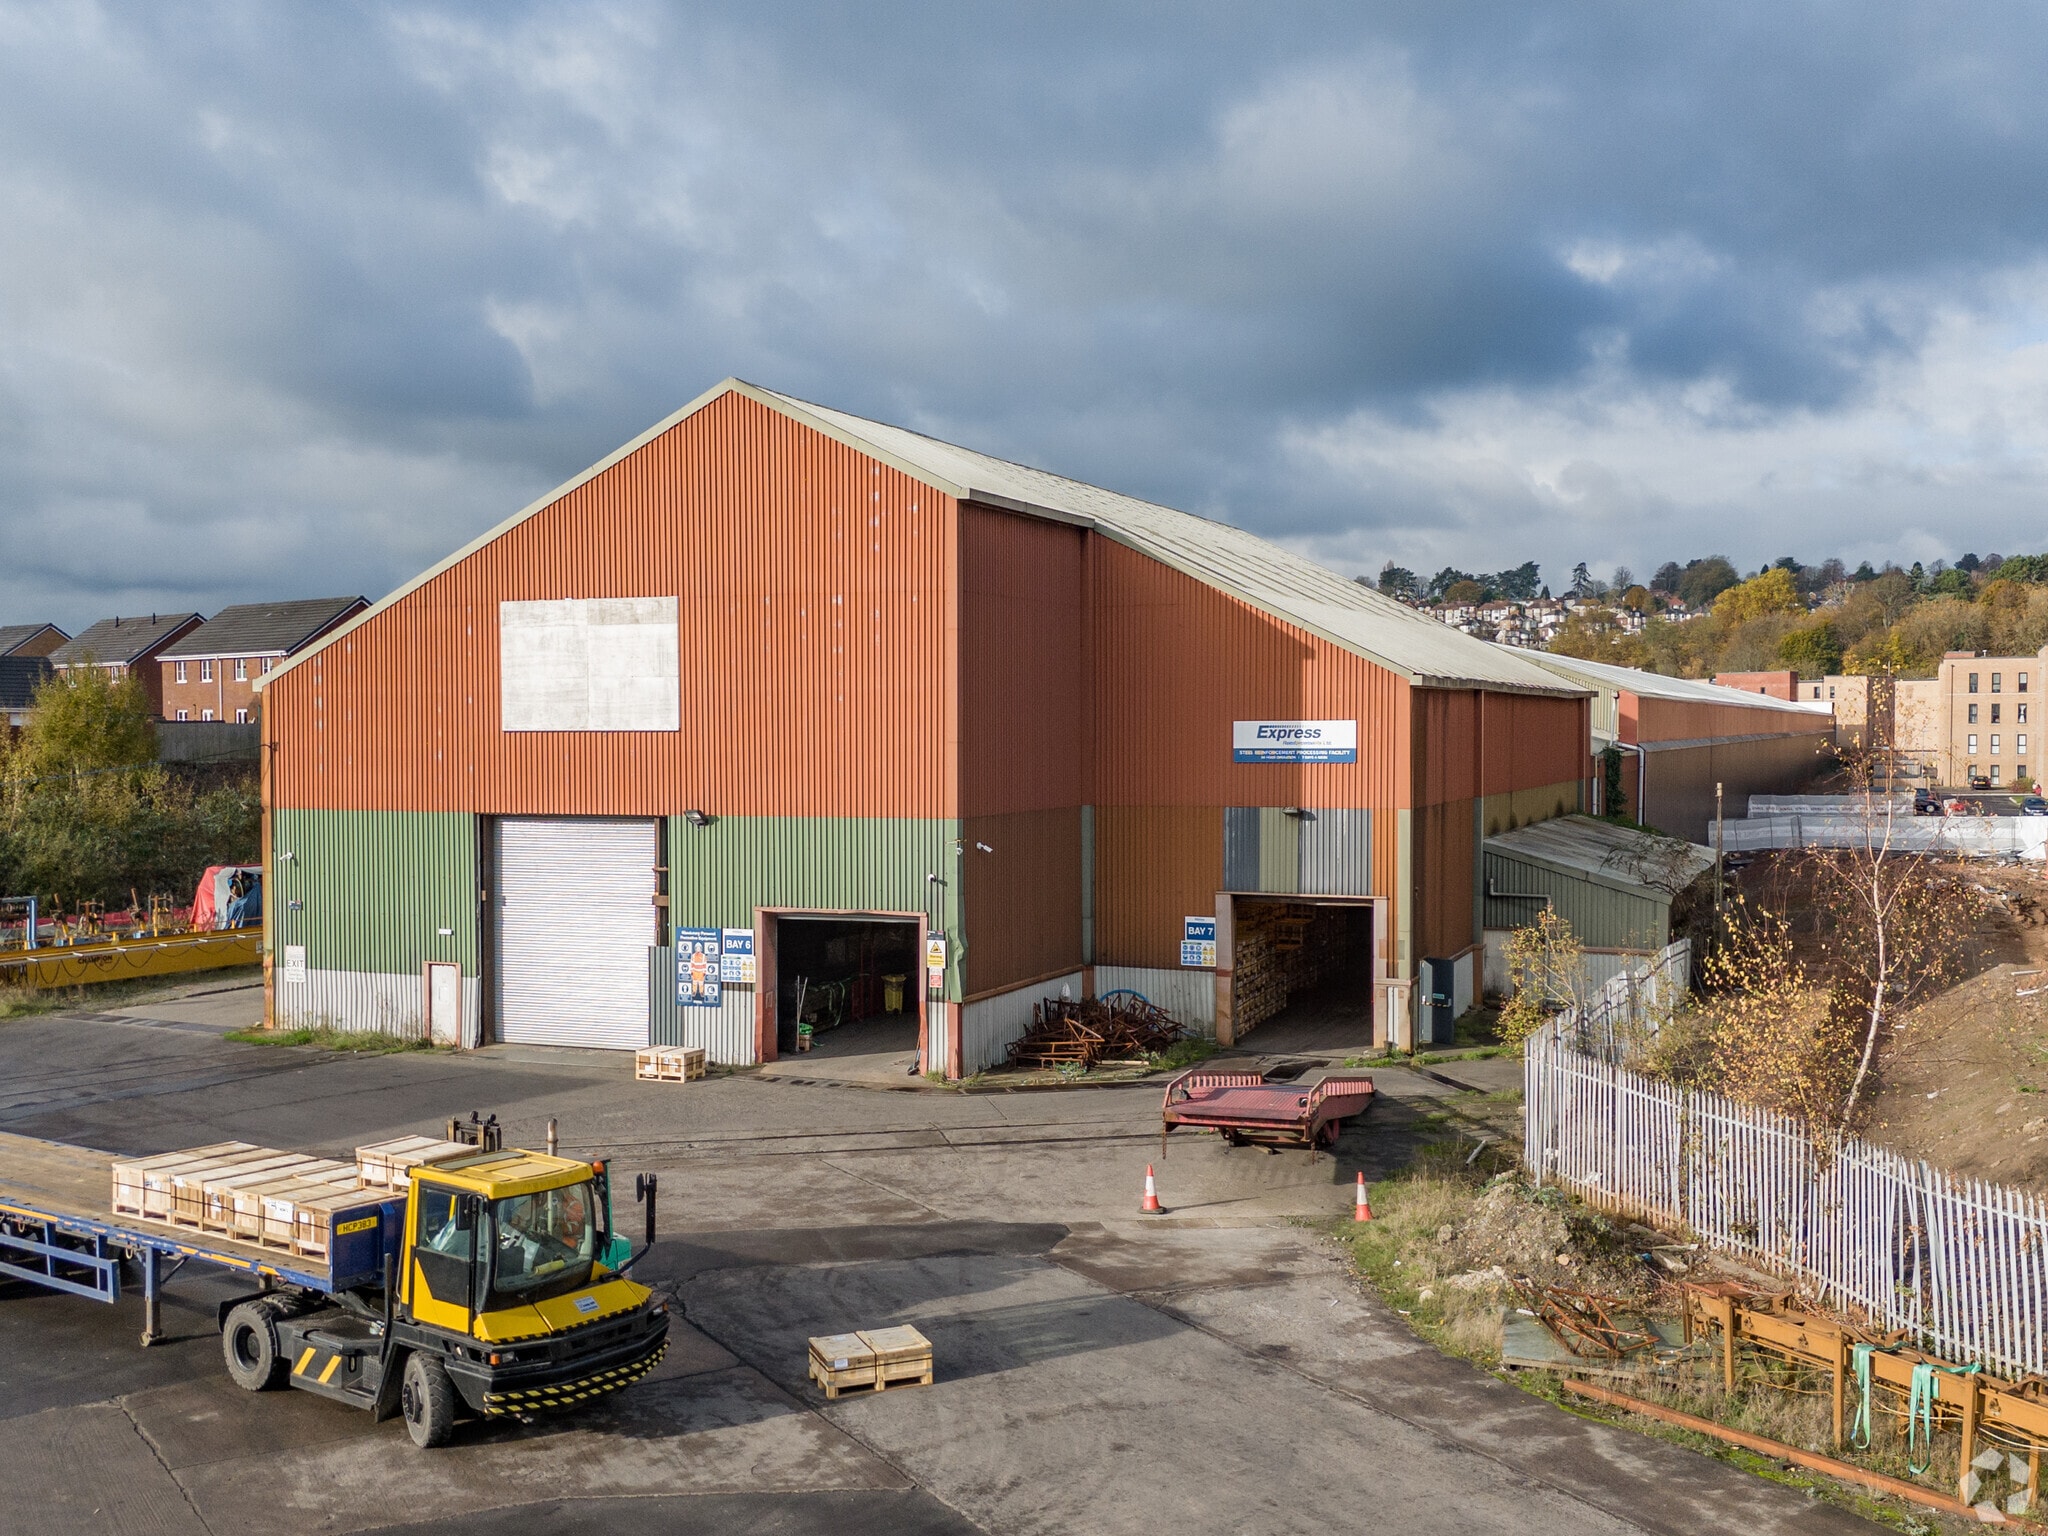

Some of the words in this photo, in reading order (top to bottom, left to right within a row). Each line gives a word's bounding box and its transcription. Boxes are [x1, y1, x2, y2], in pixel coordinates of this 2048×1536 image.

[1256, 724, 1322, 741] Express
[1188, 926, 1206, 936] BAY
[1208, 928, 1214, 936] 7
[726, 940, 744, 949] BAY
[746, 940, 751, 950] 6
[286, 960, 304, 968] EXIT
